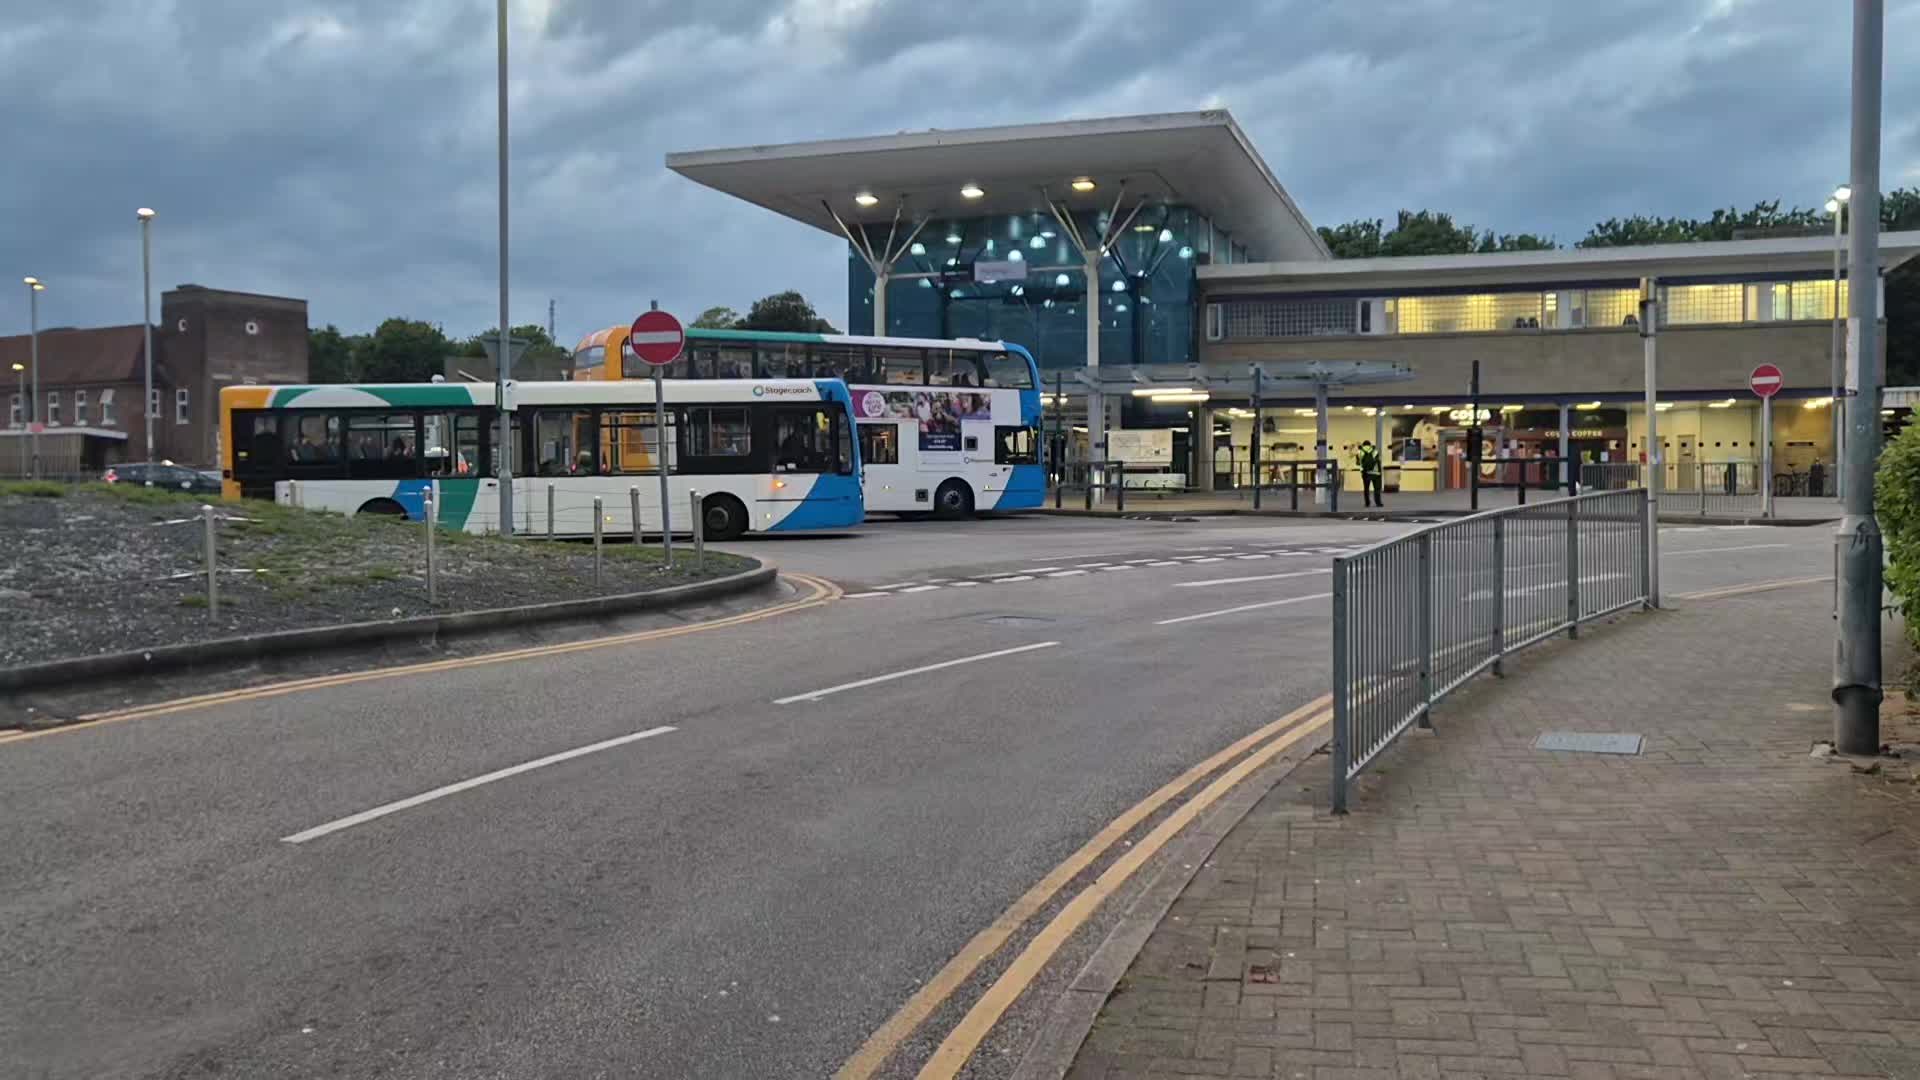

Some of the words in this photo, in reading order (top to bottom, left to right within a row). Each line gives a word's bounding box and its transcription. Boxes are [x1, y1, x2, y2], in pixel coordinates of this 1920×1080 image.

[765, 386, 812, 396] Stagecoach
[1544, 430, 1570, 438] COS
[1572, 429, 1602, 437] COFFEE
